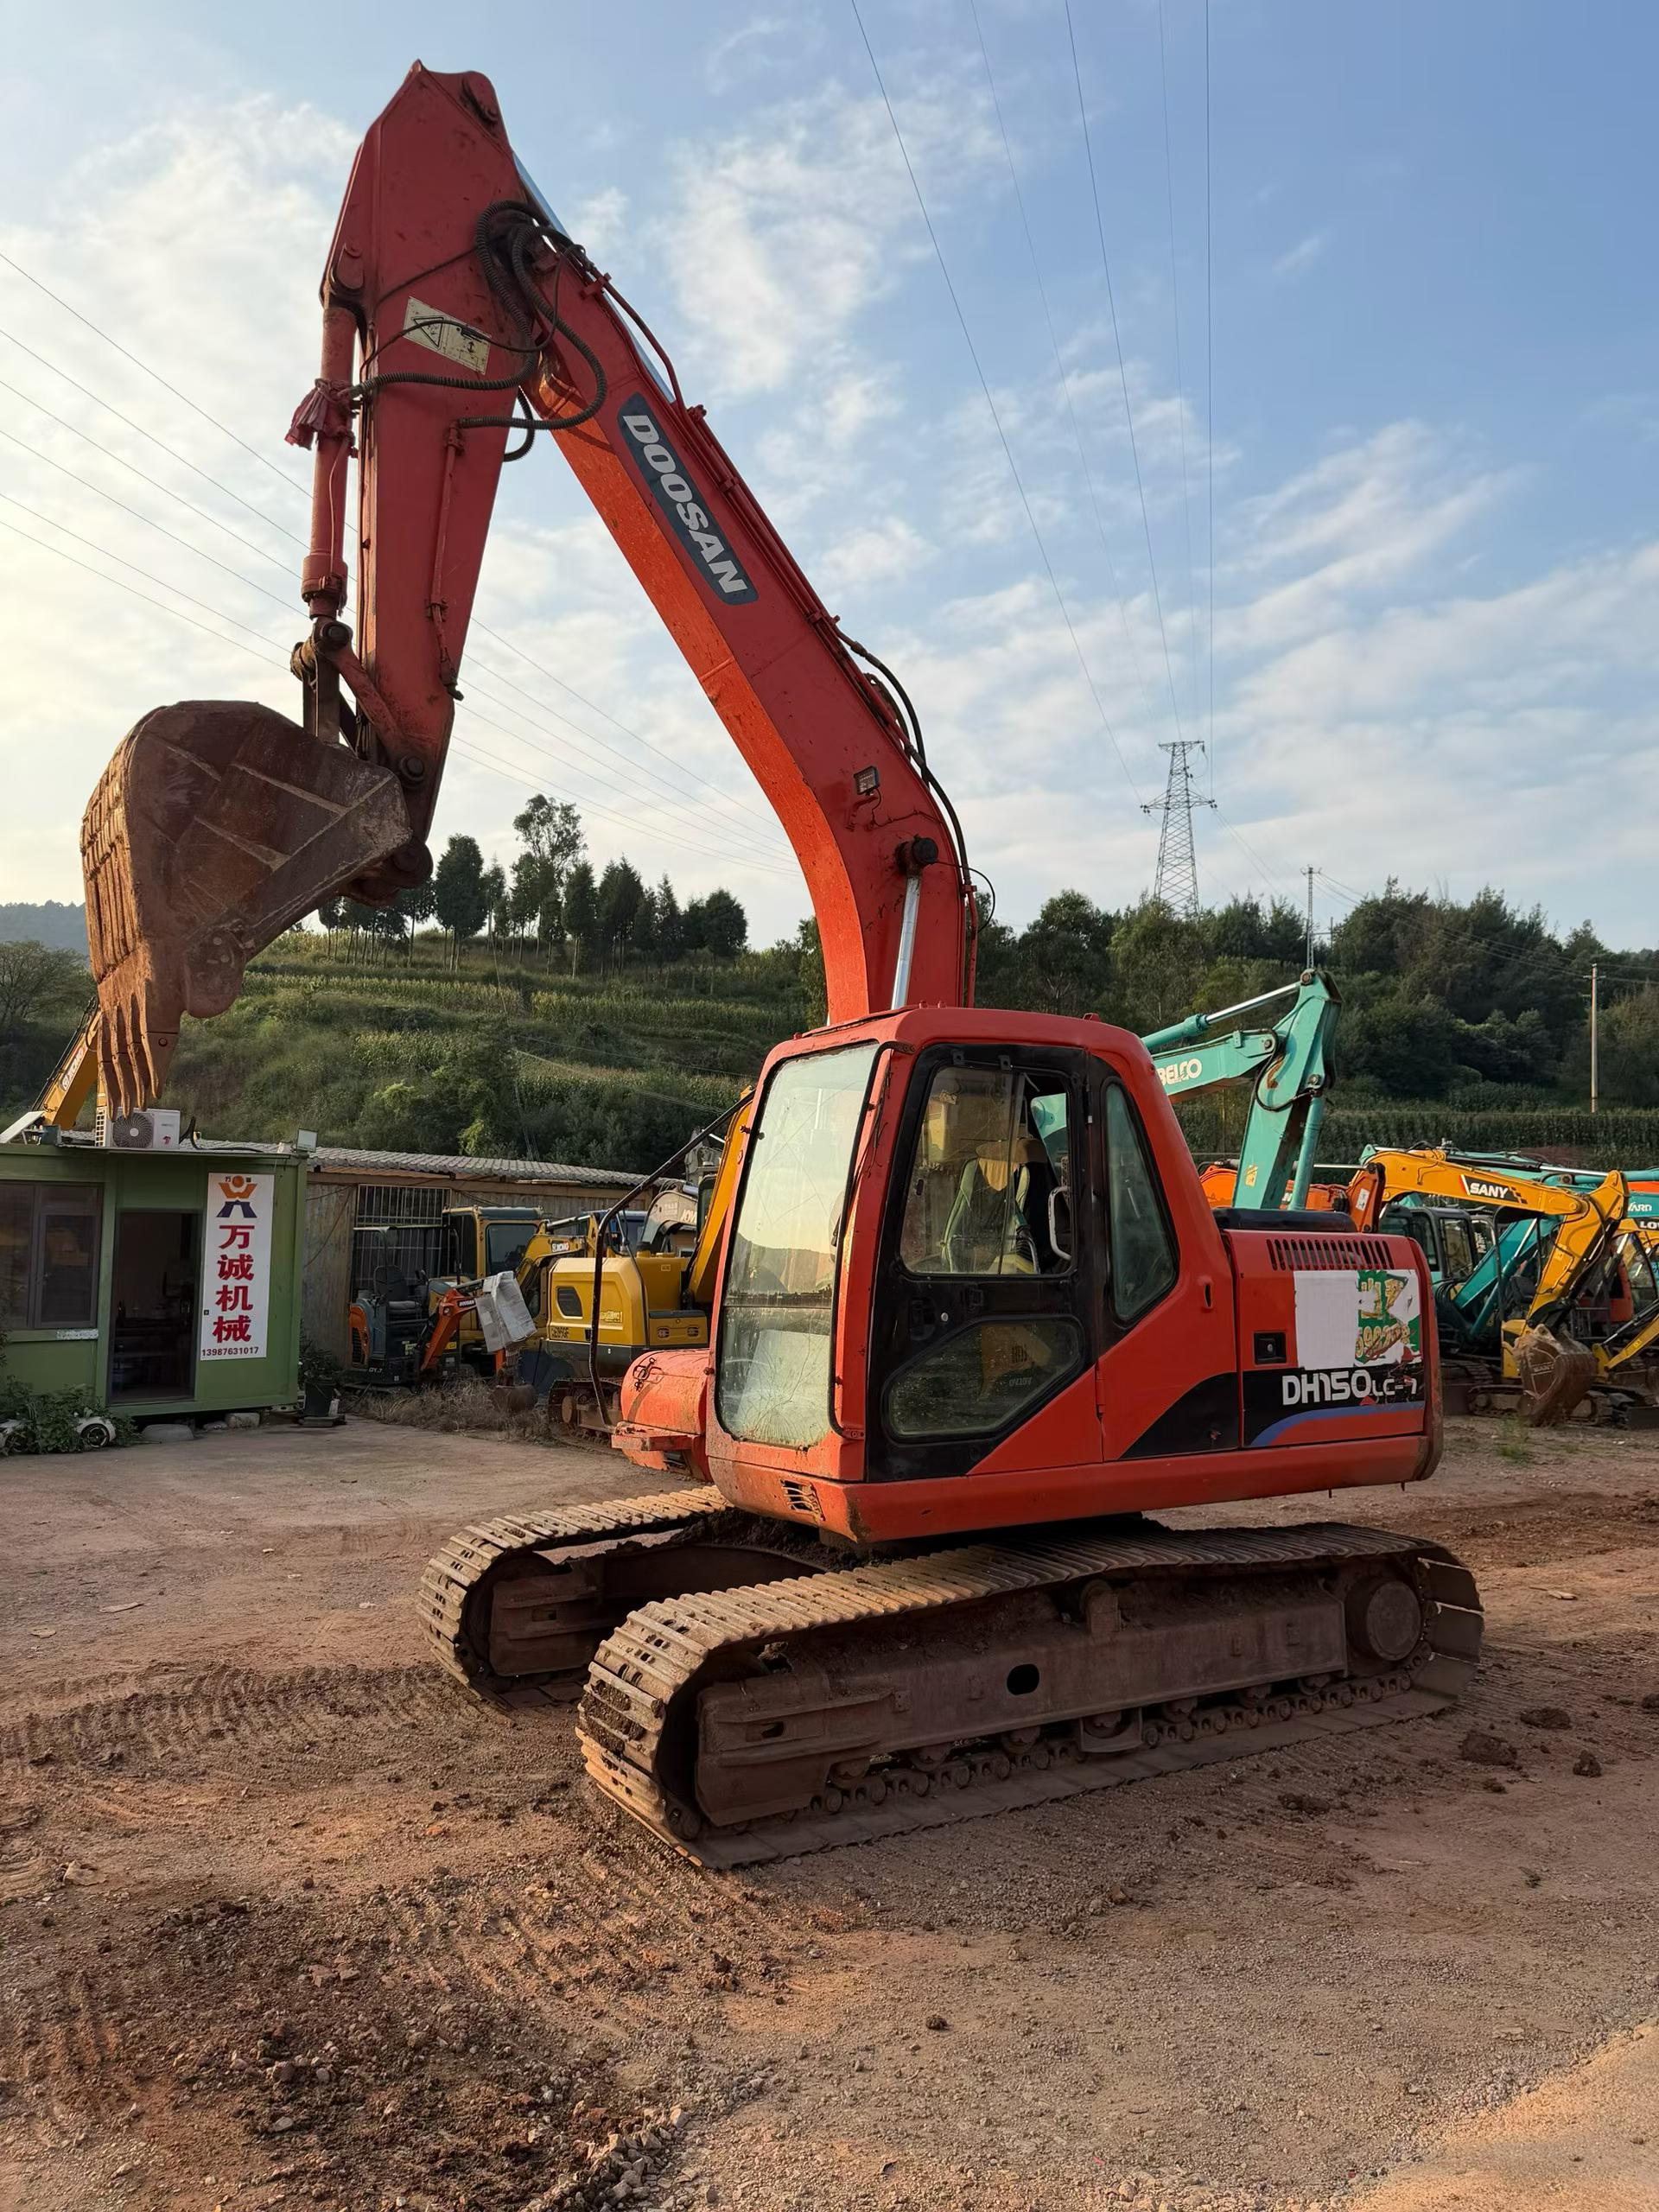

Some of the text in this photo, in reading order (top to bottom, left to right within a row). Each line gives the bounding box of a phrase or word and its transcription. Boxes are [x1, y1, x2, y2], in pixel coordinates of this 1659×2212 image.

[623, 415, 747, 593] DOOSAN
[1470, 1182, 1508, 1198] SANY
[1640, 1220, 1659, 1230] LO
[213, 1224, 255, 1344] 万诚机械
[201, 1345, 259, 1357] 13987631017
